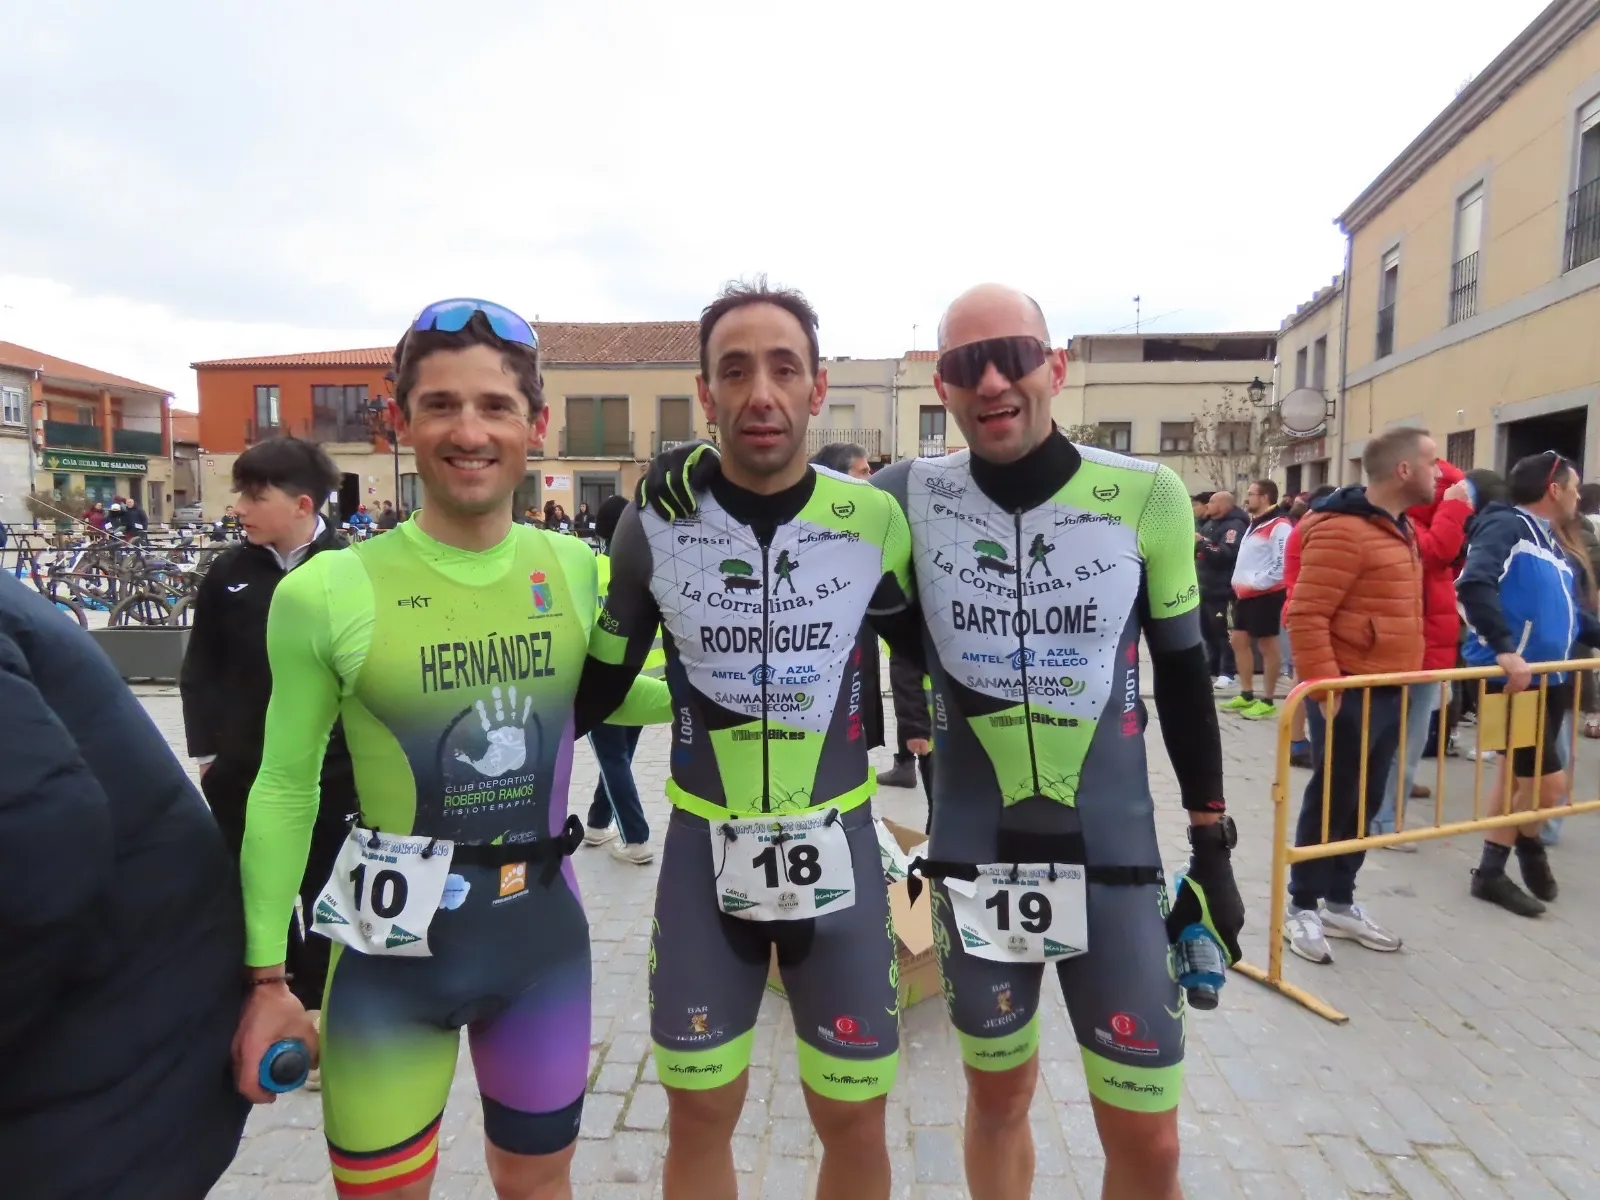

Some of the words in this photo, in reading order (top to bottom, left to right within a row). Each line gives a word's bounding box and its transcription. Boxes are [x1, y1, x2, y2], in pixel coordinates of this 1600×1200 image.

[946, 508, 988, 527] PISSEI
[690, 537, 730, 545] PISSEI
[932, 551, 955, 575] La
[1074, 556, 1117, 581] S.L.
[680, 581, 702, 602] La
[815, 575, 852, 599] S.L.
[951, 597, 1099, 637] BARTOLOMÉ
[700, 620, 833, 654] RODRÍGUEZ
[420, 631, 556, 693] HERNÁNDEZ
[961, 651, 1004, 665] AMTEL
[1046, 648, 1080, 657] AZUL
[786, 665, 816, 674] AZUL
[1039, 657, 1088, 668] TELECO
[711, 671, 747, 681] AMTEL
[778, 674, 821, 685] TELECO
[1002, 687, 1069, 697] TELECOM
[744, 703, 801, 712] TELECOM
[936, 694, 949, 731] LOCA
[680, 706, 693, 745] LOCA
[445, 782, 474, 794] CLUB
[478, 773, 535, 790] DEPORTIVO
[443, 790, 496, 807] ROBERTO
[499, 784, 534, 800] RAMOS
[752, 844, 822, 888] 18
[324, 893, 339, 907] FRAN
[350, 863, 408, 919] 10
[985, 890, 1052, 934] 19
[991, 981, 1011, 993] BAR
[687, 1006, 709, 1014] BAR
